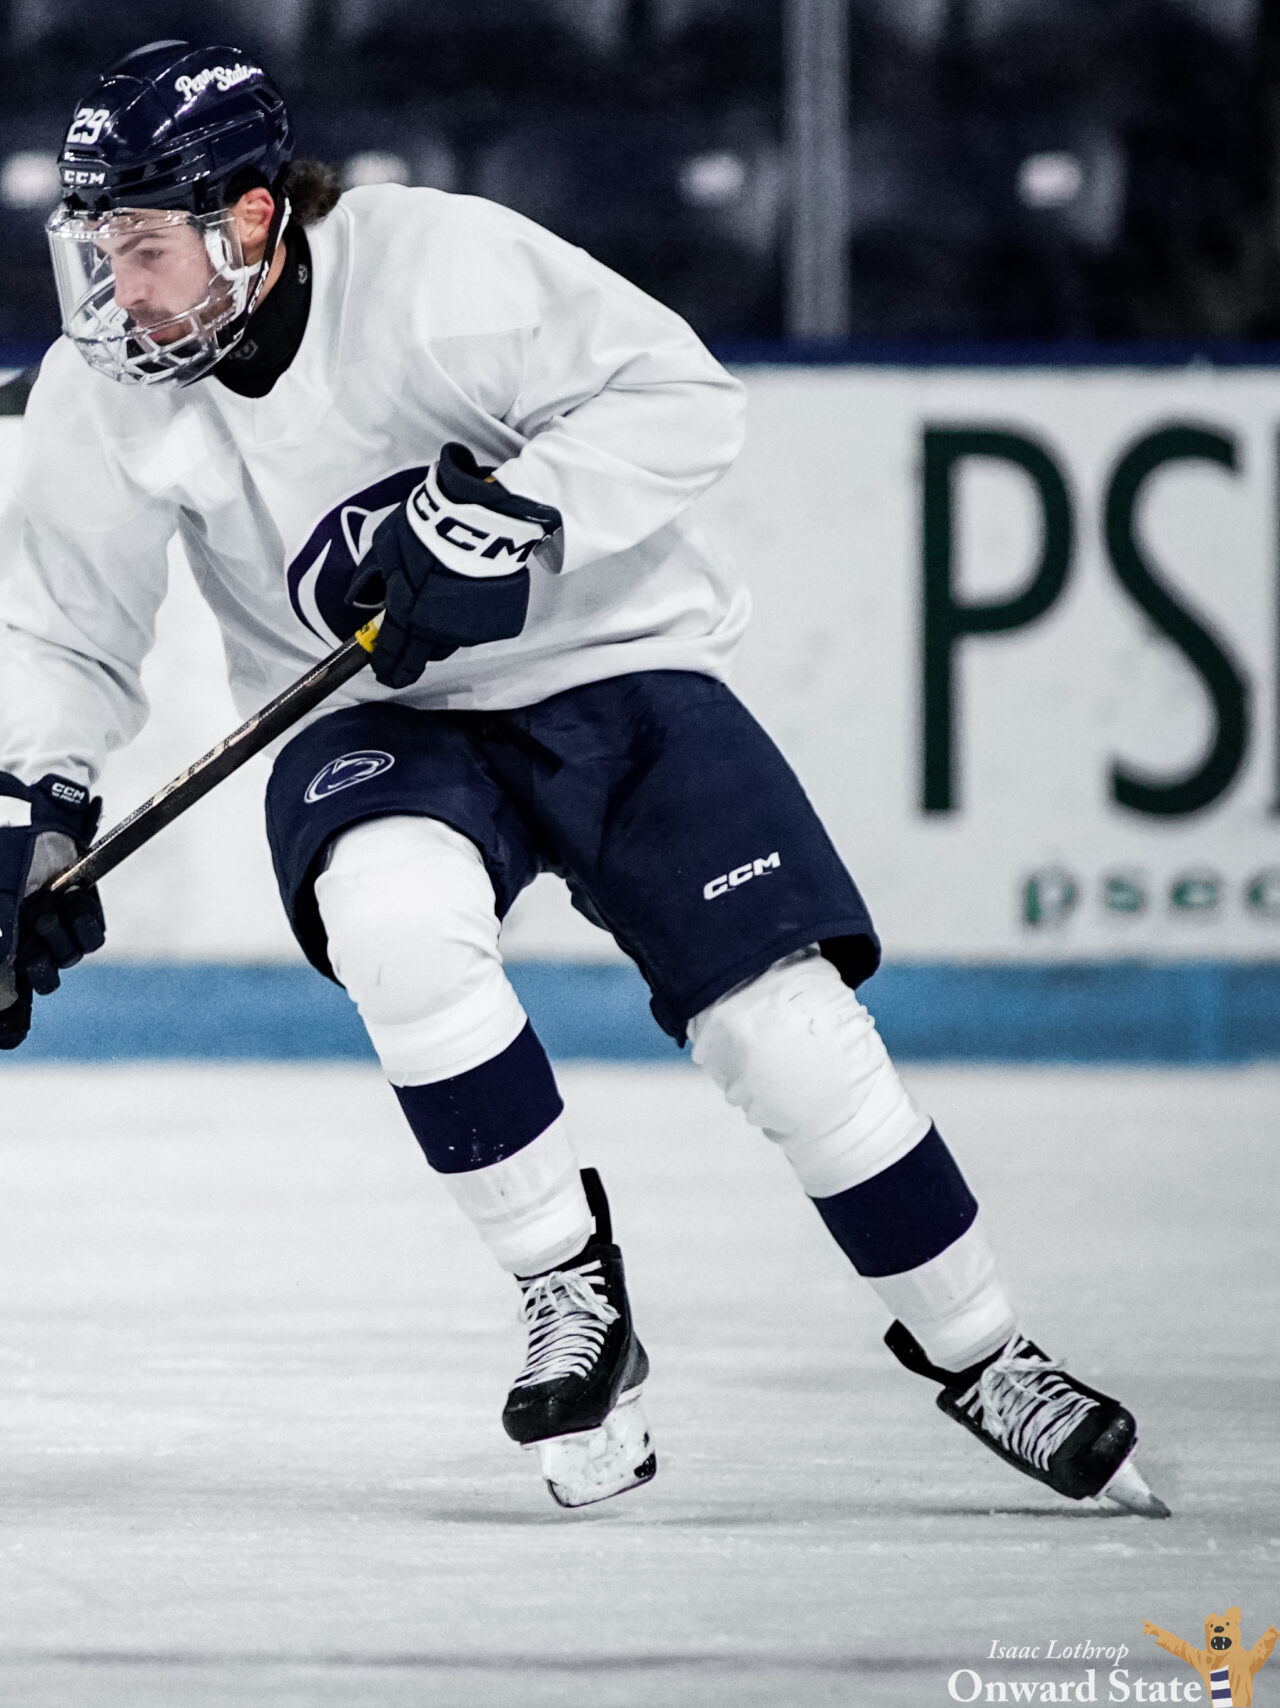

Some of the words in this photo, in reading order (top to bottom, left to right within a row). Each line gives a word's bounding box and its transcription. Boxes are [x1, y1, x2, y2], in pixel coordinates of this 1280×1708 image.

[174, 68, 213, 102] Penn
[66, 107, 110, 145] 29
[63, 169, 106, 185] CCM
[413, 483, 541, 562] CCM
[51, 782, 85, 801] CCM
[703, 851, 781, 900] CCM
